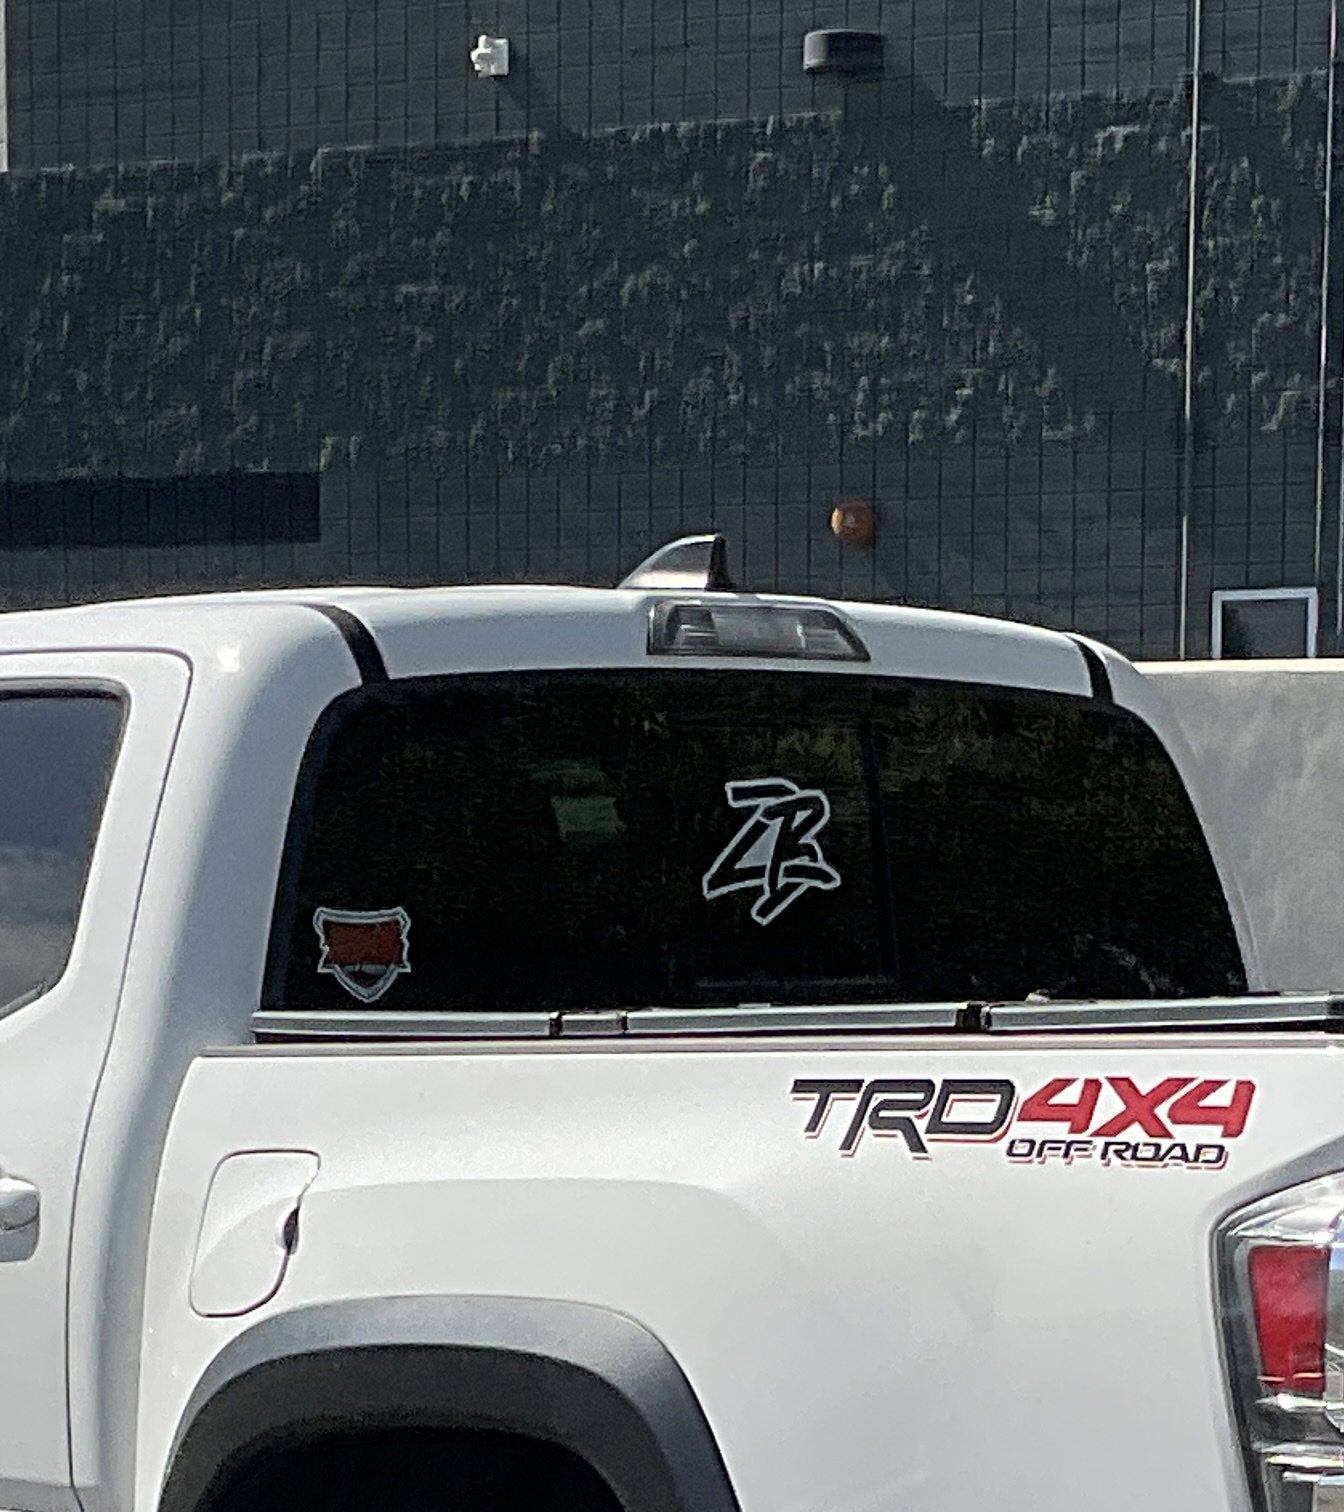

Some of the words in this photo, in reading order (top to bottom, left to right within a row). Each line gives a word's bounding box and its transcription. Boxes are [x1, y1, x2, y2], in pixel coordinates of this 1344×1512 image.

[790, 1078, 1017, 1159] TRD
[1017, 1076, 1256, 1139] 4X4
[1006, 1138, 1096, 1165] OFF
[1099, 1139, 1229, 1170] ROAD
